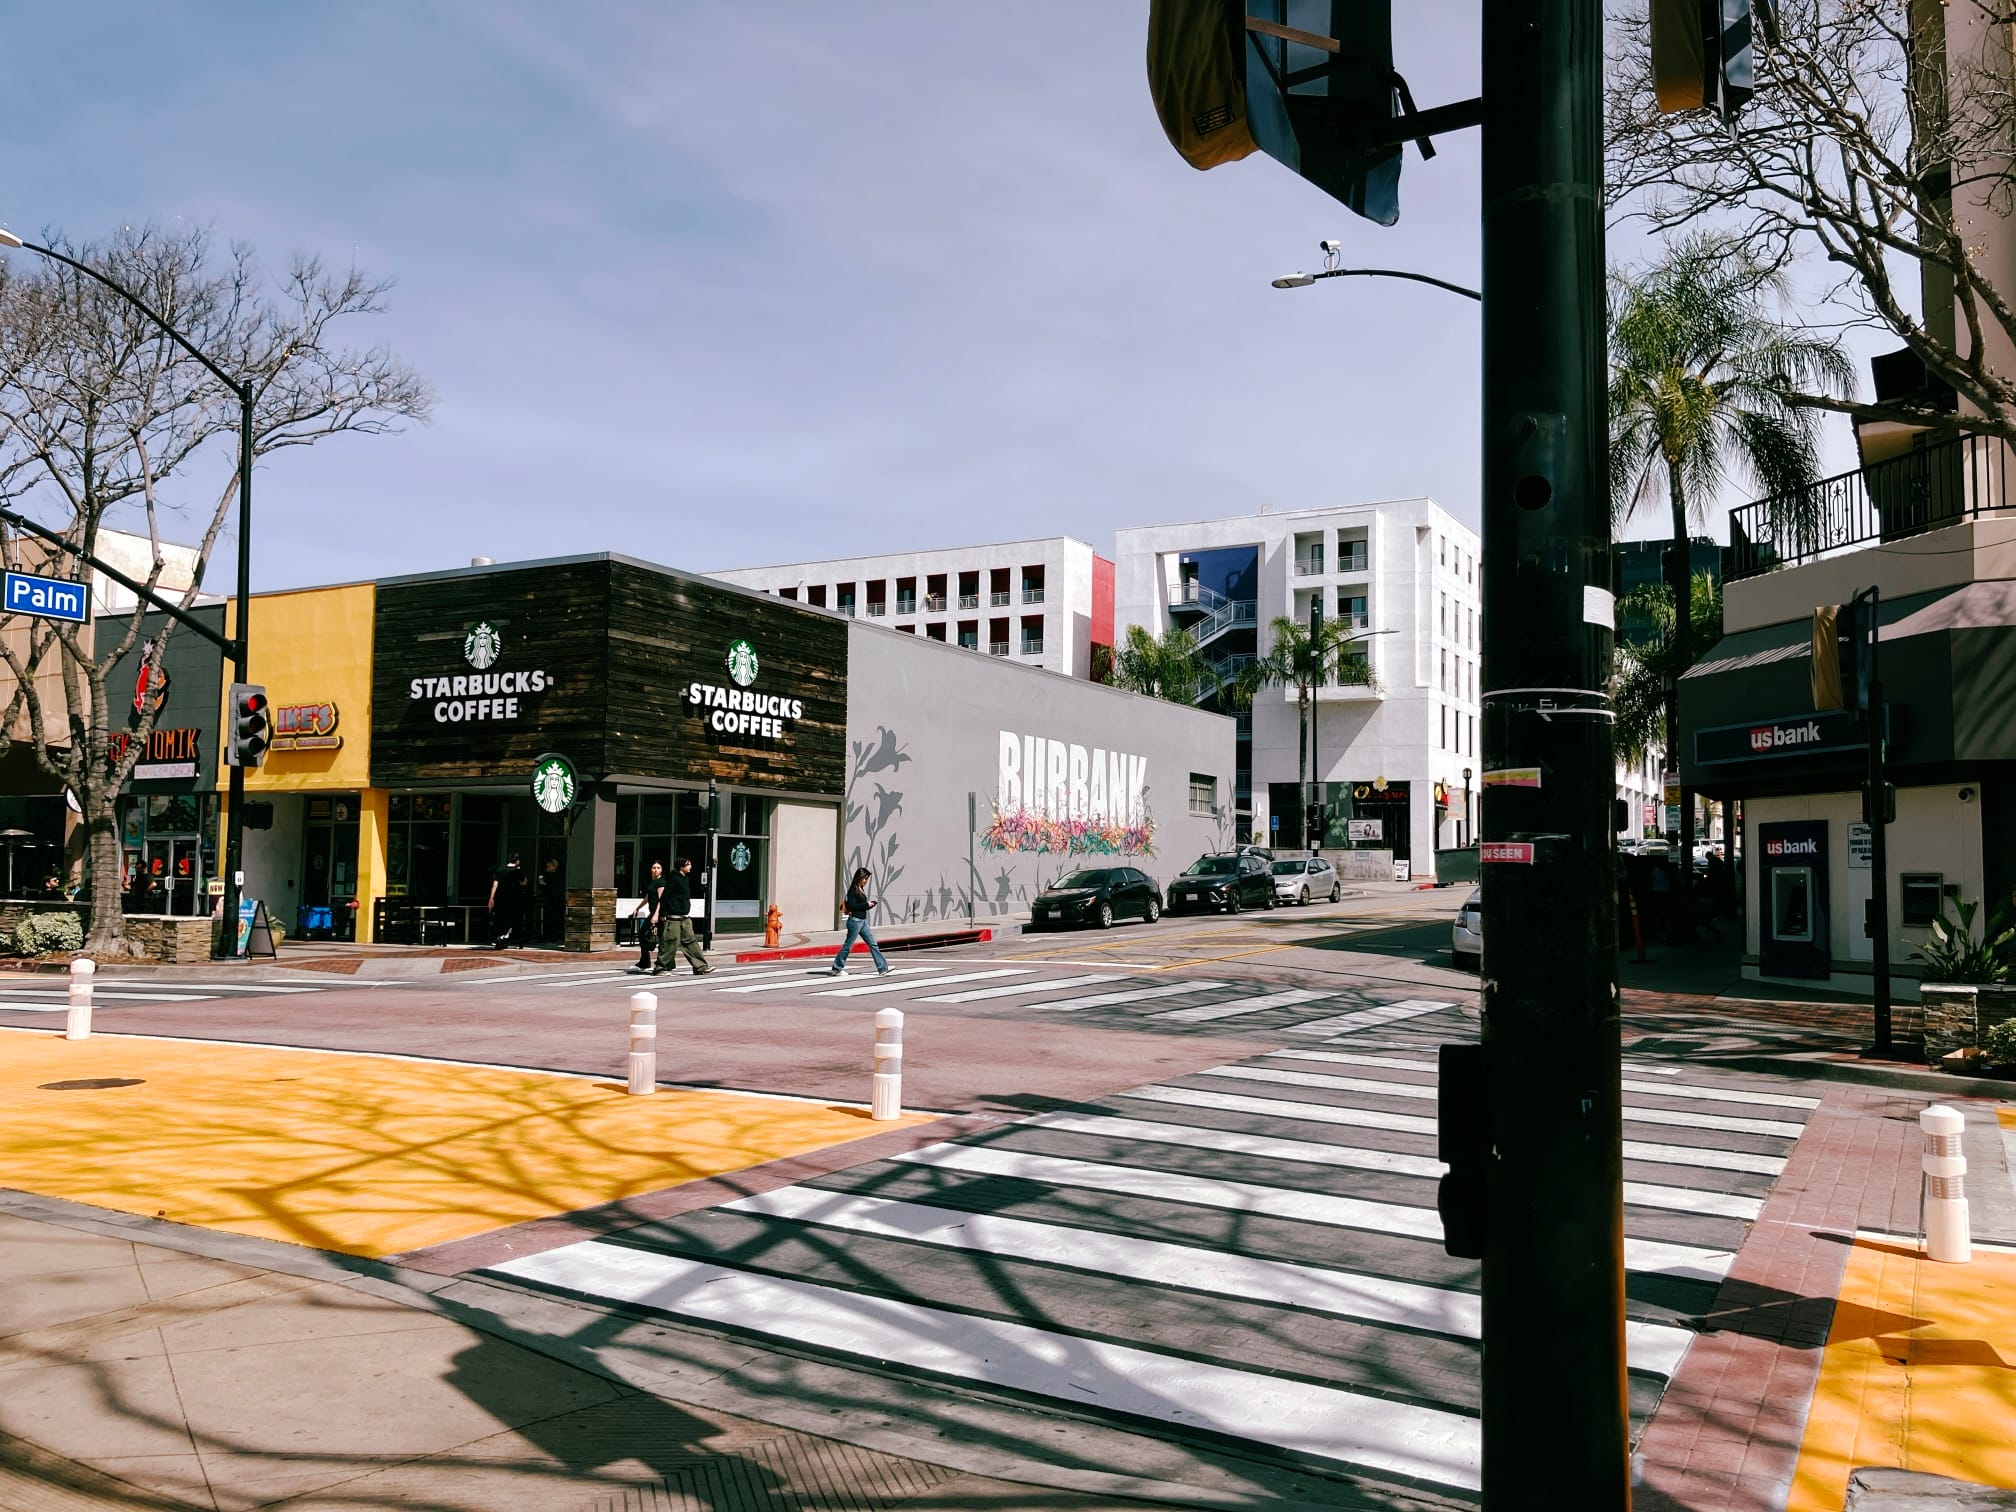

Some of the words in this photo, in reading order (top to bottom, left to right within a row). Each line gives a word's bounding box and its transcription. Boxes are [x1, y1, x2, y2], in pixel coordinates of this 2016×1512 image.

[13, 579, 78, 613] Palm
[410, 670, 545, 700] STARBUCKS
[434, 697, 518, 723] COFFEE
[689, 682, 802, 720] STARBUCKS
[277, 704, 332, 732] IKE'S
[711, 709, 782, 739] COFFEE
[998, 730, 1148, 828] BURBANK
[1493, 848, 1523, 859] SEEN
